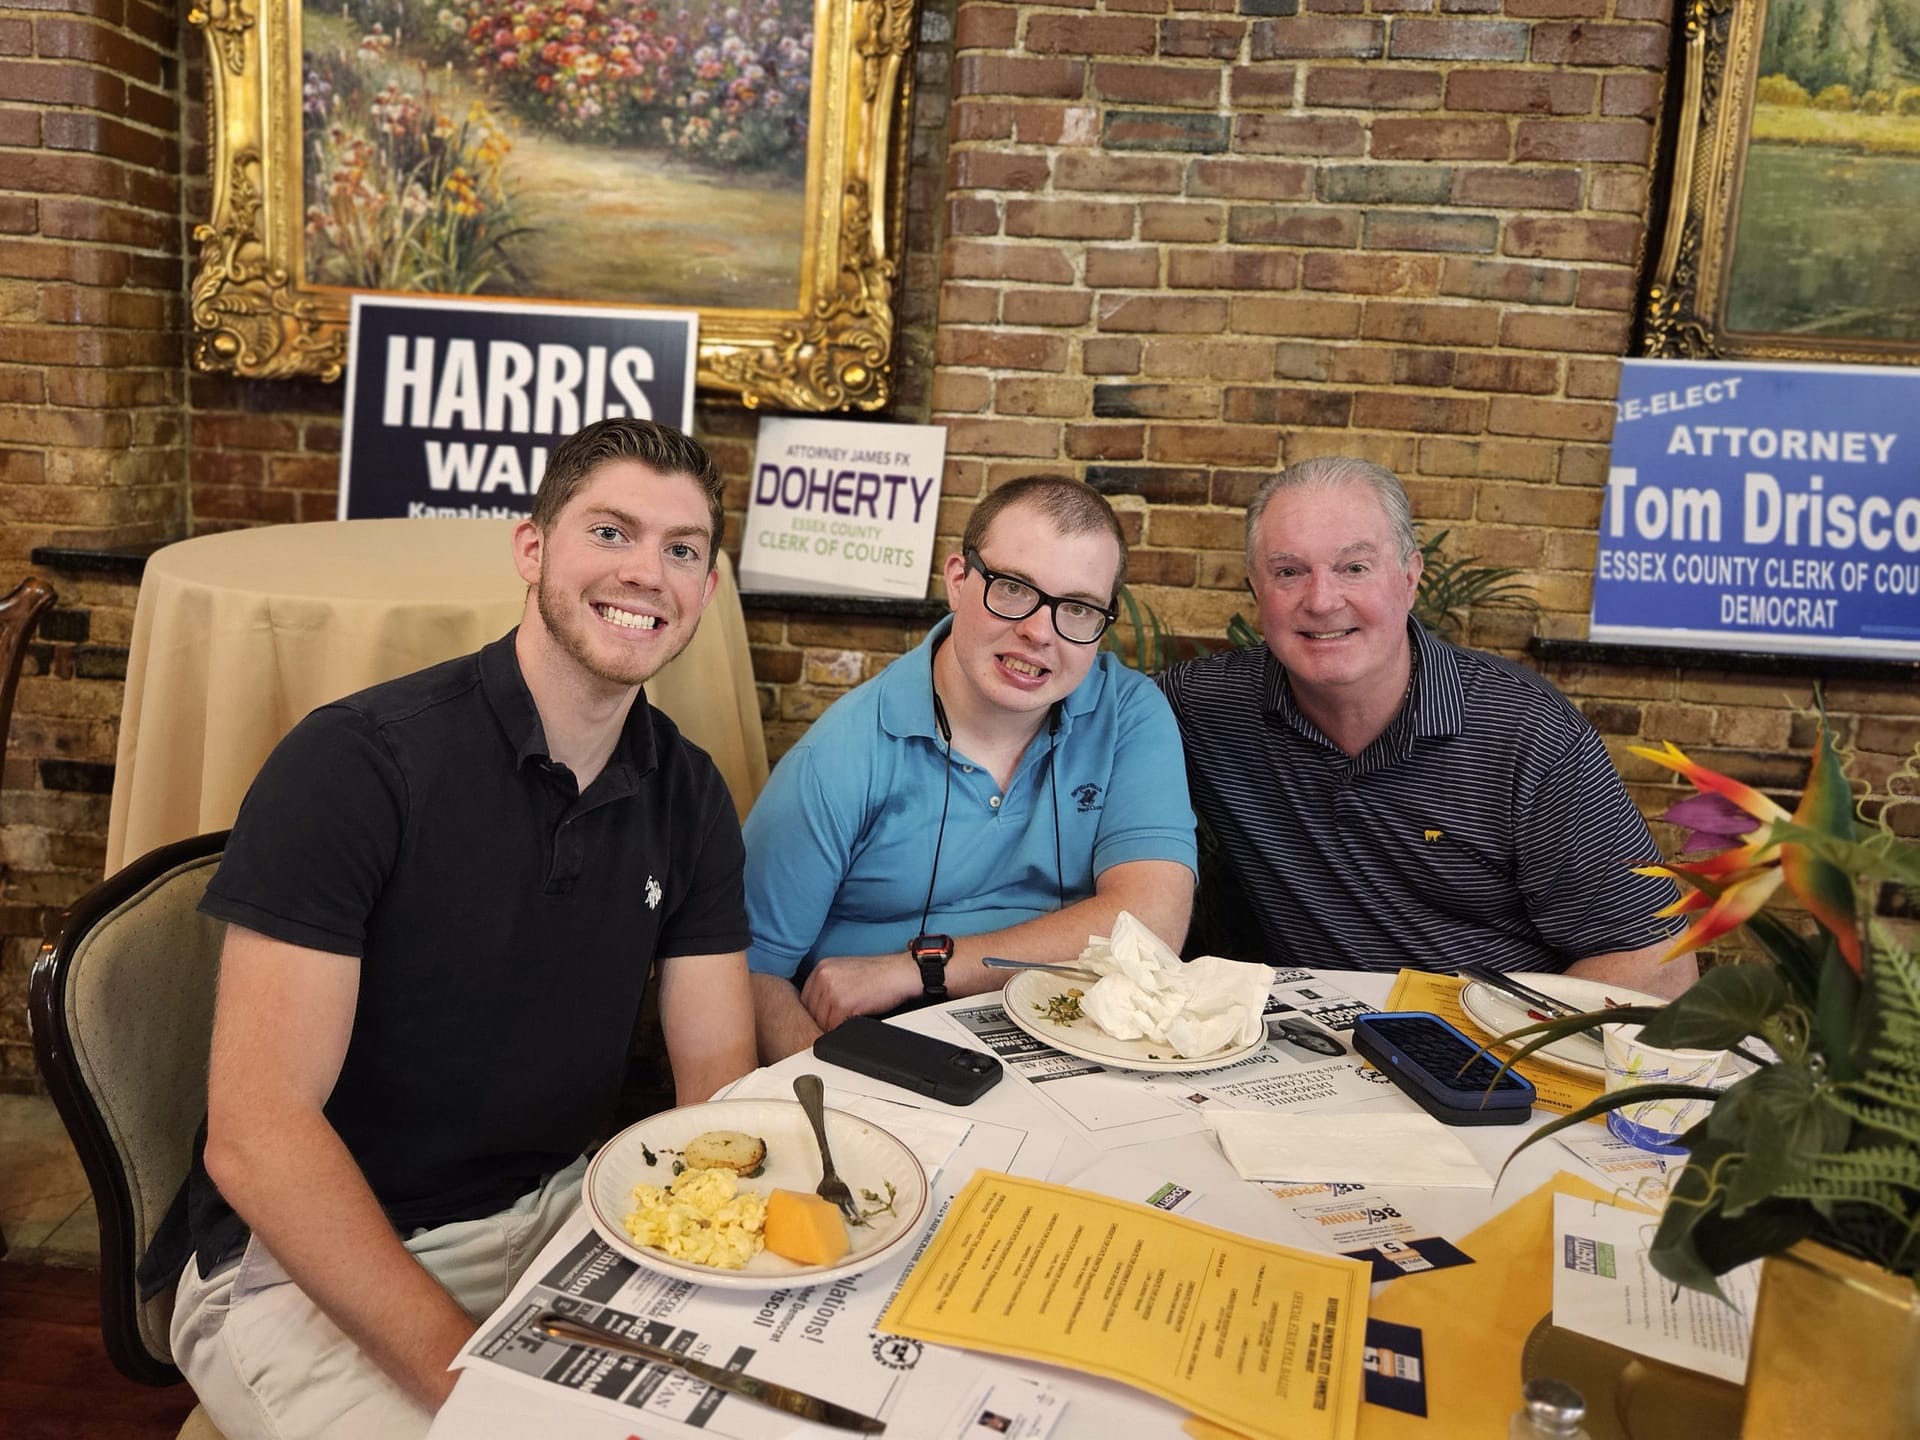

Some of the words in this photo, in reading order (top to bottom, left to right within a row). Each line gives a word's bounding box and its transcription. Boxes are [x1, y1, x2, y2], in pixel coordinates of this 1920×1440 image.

[383, 335, 654, 435] HARRIS
[786, 444, 847, 463] ATTORNEY
[850, 450, 892, 465] JAMES
[894, 452, 911, 467] FX
[1667, 425, 1897, 464] ATTORNEY
[755, 463, 934, 523] DOHERTY
[1608, 467, 1721, 542] Tom
[791, 516, 827, 532] ESSEX
[829, 520, 883, 541] COUNTY
[758, 530, 810, 552] CLERK
[813, 537, 839, 556] OF
[843, 541, 915, 568] COURTS
[1600, 551, 1668, 582] ESSEX
[1672, 553, 1760, 587] COUNTY
[1764, 558, 1835, 591] CLERK
[1840, 563, 1869, 592] OF
[1721, 594, 1838, 629] DEMOCRAT
[1225, 1078, 1305, 1097] COMMITTEE
[1248, 1081, 1333, 1101] DEMOCRATIC
[1264, 1088, 1338, 1106] HAVERHILL
[1316, 1211, 1367, 1226] THINK
[1366, 1207, 1402, 1225] 86%
[1383, 1242, 1401, 1253] 5
[800, 1273, 862, 1344] ulations!
